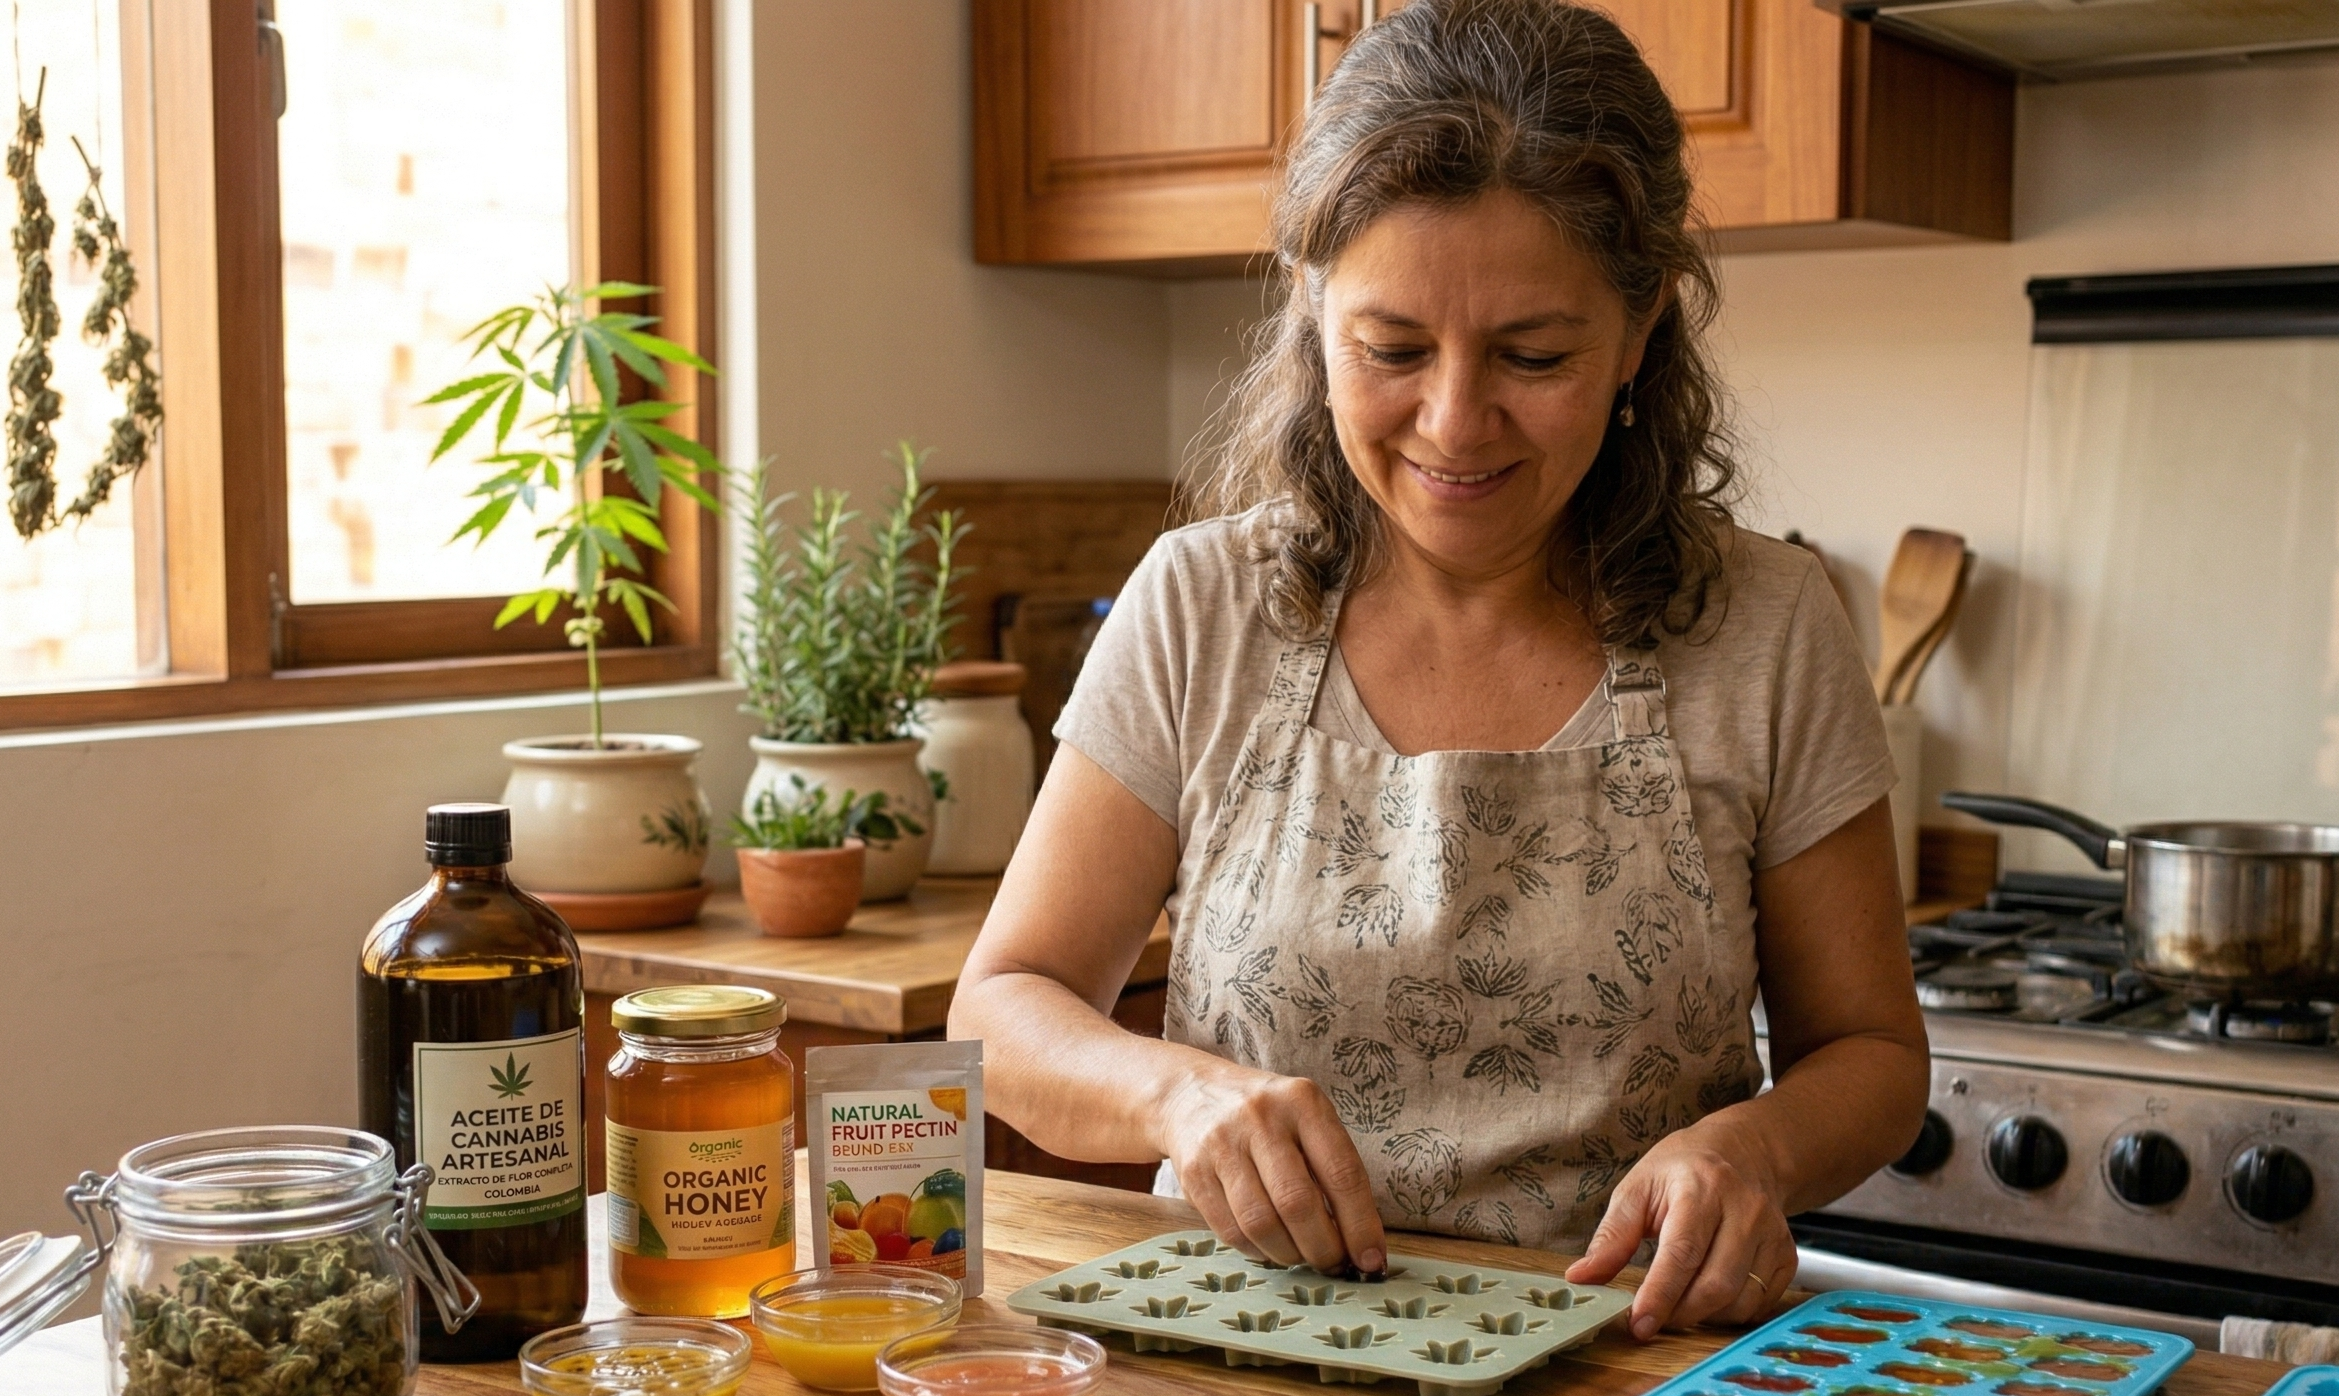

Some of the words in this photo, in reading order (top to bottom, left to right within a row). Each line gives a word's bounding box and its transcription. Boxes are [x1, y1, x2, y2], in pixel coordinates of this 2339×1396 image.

[450, 1105, 534, 1127] ACEITE
[540, 1099, 564, 1120] DE
[832, 1103, 923, 1122] NATURAL
[450, 1121, 565, 1149] CANNABIS
[832, 1124, 887, 1141] FRUIT
[891, 1120, 958, 1139] PECTIN
[441, 1141, 570, 1170] ARTESANAL
[438, 1175, 489, 1186] EXTRACTO
[492, 1174, 506, 1184] DE
[508, 1172, 533, 1183] FLOR
[663, 1164, 767, 1189] ORGANIC
[484, 1184, 541, 1199] COLOMBIA
[665, 1185, 768, 1215] HONEY
